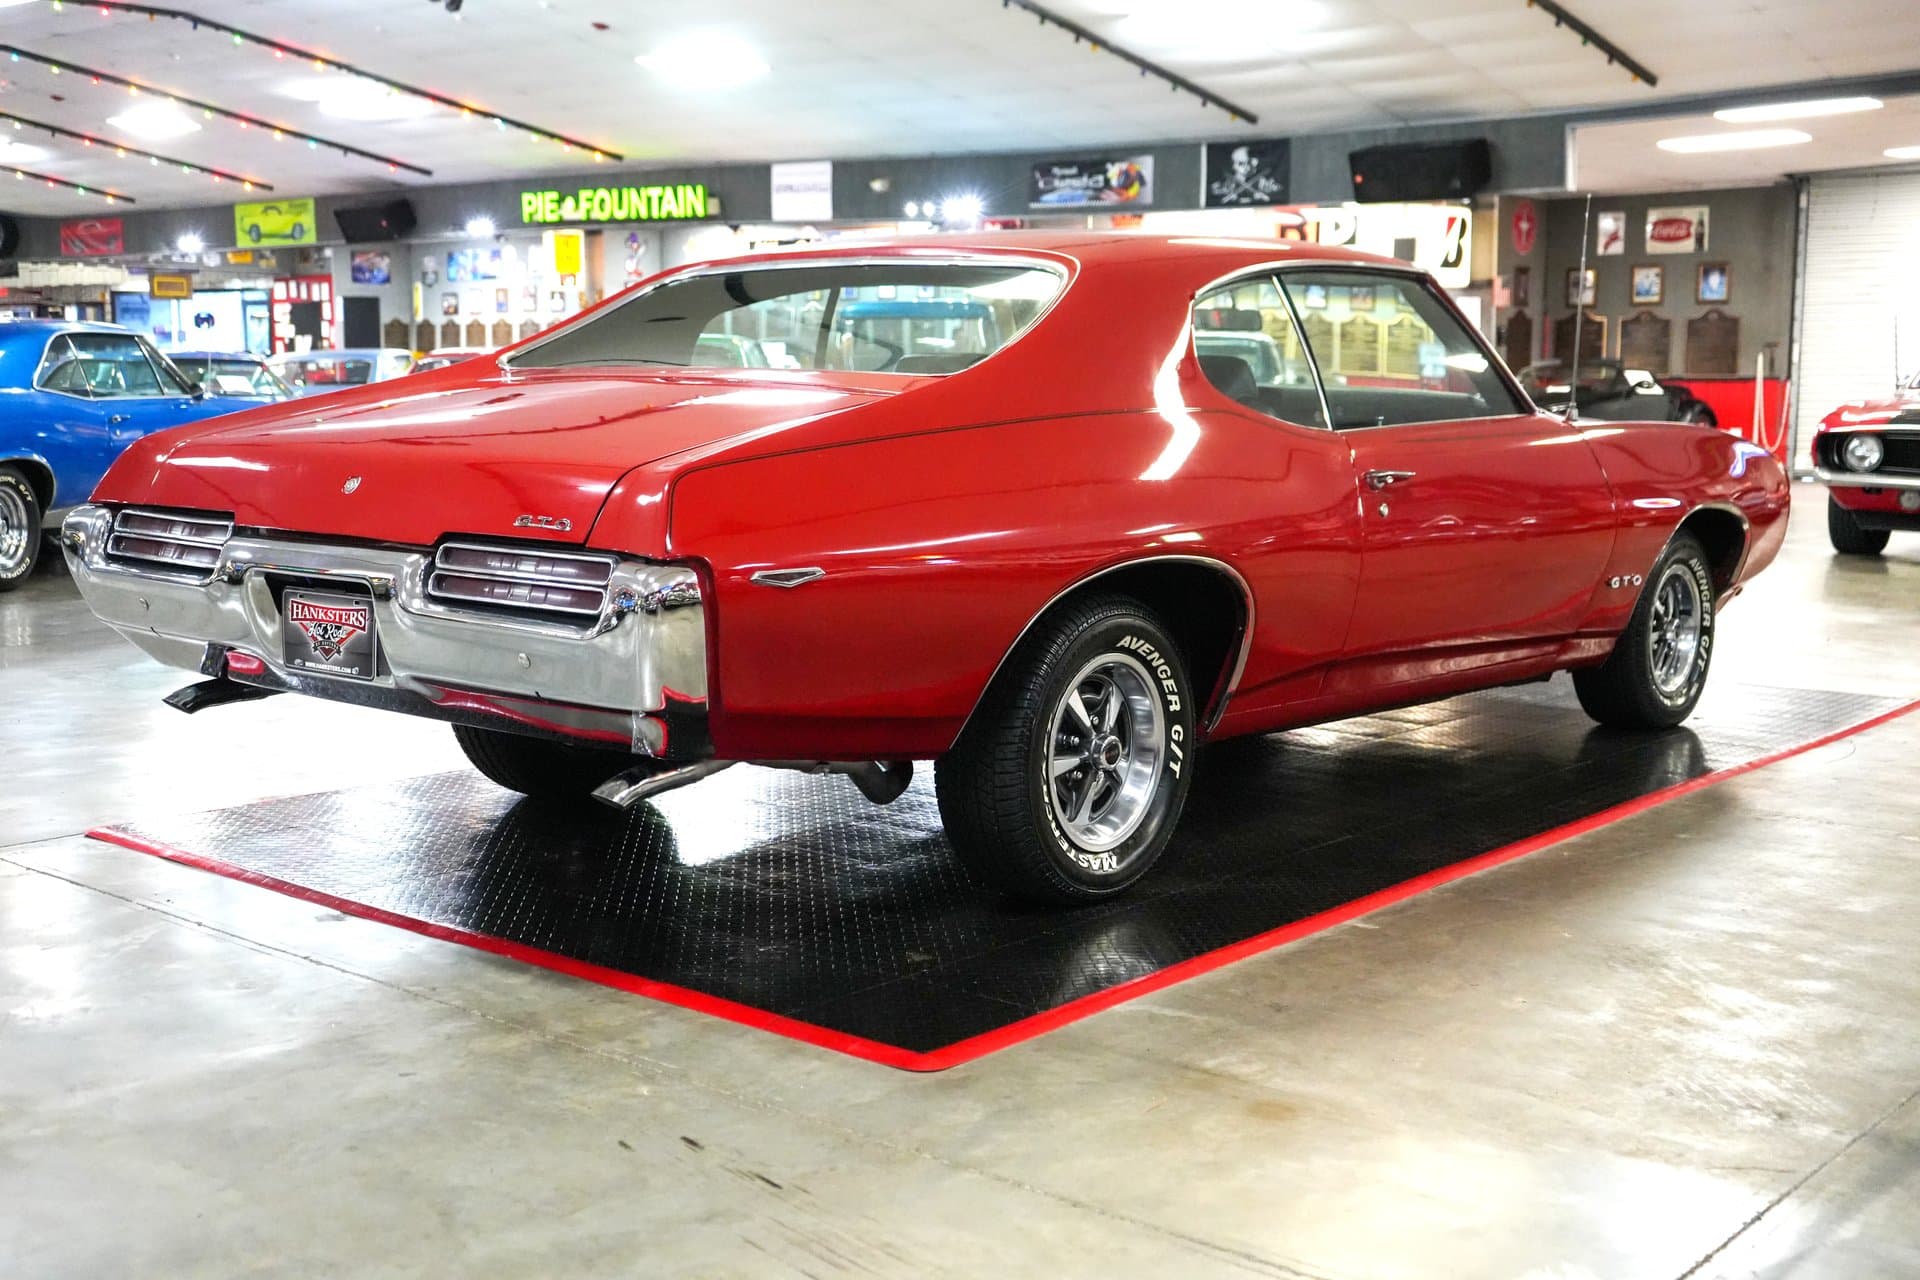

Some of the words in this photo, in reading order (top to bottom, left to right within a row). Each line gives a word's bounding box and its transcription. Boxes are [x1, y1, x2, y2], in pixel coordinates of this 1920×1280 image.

[521, 191, 561, 223] PIE
[578, 184, 707, 221] FOUNTAIN
[513, 514, 572, 531] GTO
[1610, 574, 1642, 589] GTO
[1688, 557, 1712, 628] AVENGER
[292, 602, 366, 628] HANKSTERS
[308, 621, 326, 638] Hot
[1697, 635, 1710, 672] G/T
[1116, 634, 1181, 712] AVENGER
[1168, 724, 1184, 779] G/T
[1042, 712, 1118, 872] MASTERC
